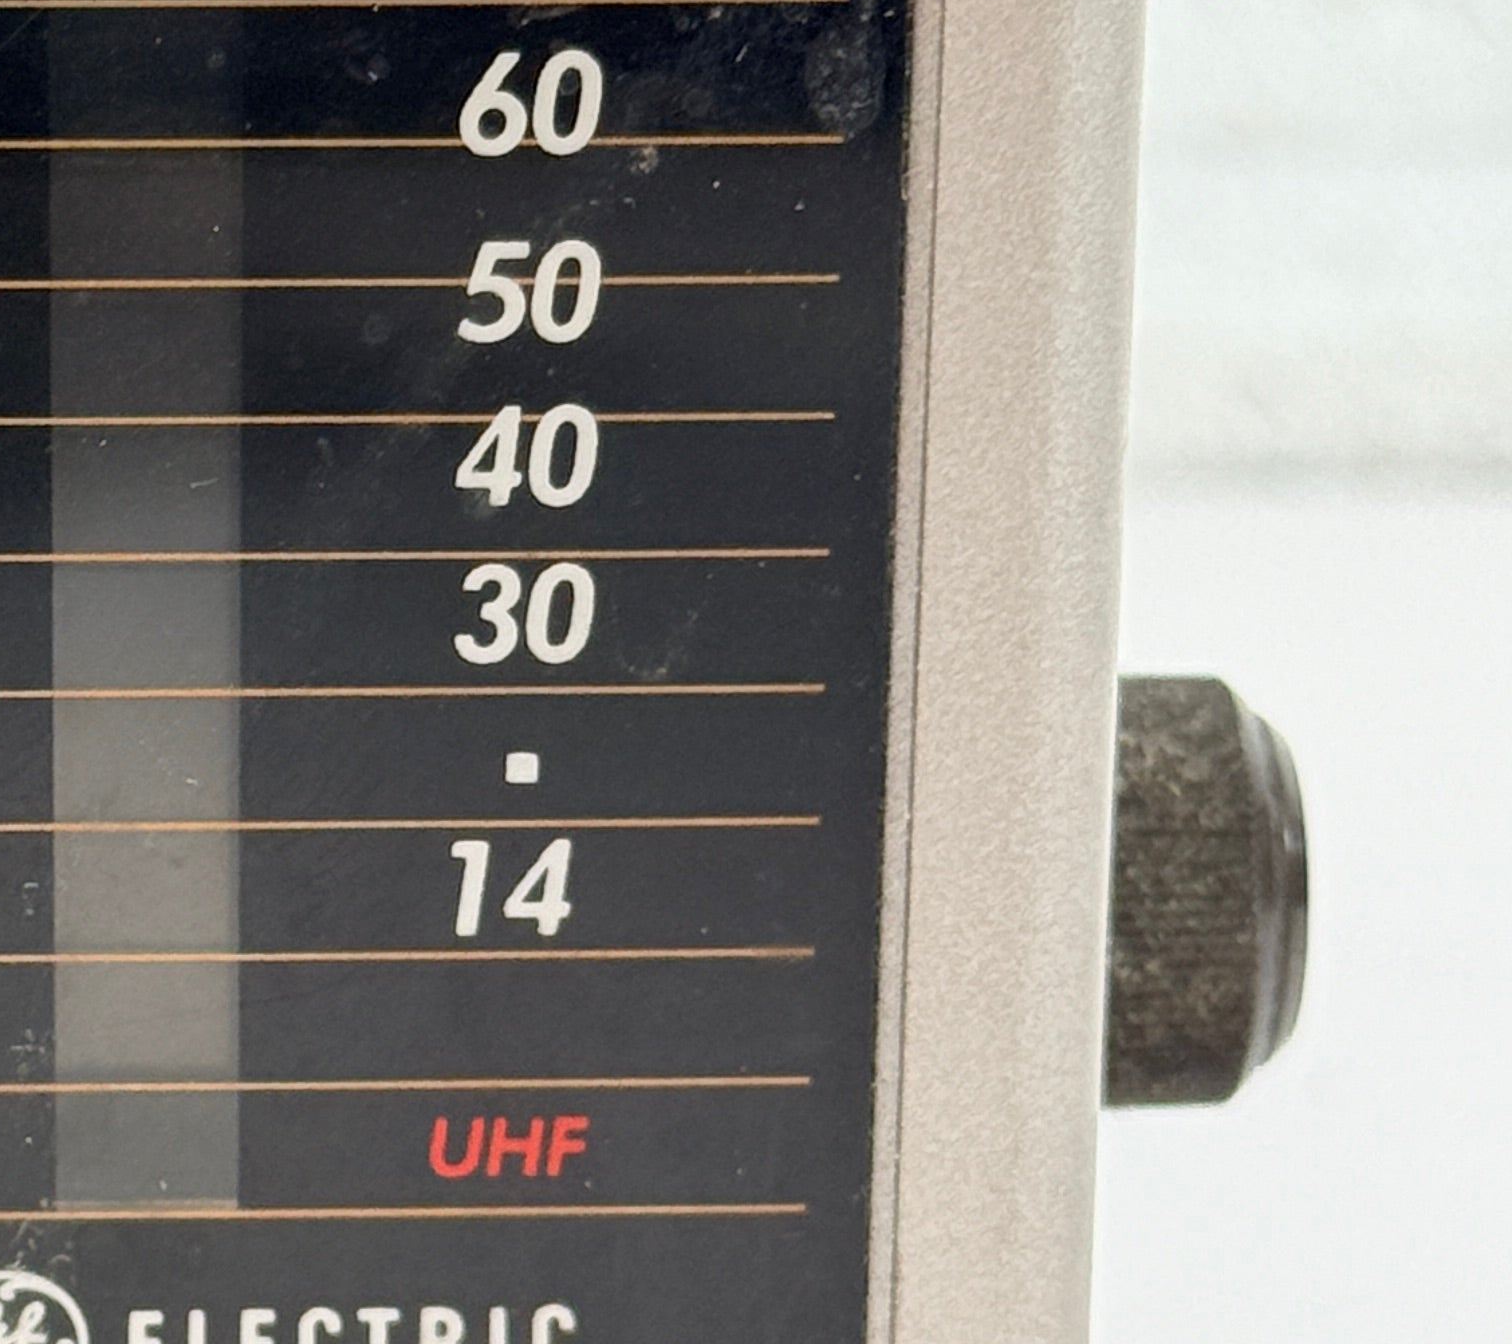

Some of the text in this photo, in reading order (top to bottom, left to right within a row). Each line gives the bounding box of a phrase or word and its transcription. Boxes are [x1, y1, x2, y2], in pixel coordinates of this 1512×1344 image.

[459, 49, 603, 156] 60
[458, 239, 602, 343] 50
[455, 403, 599, 507] 40
[454, 562, 595, 665] 30
[451, 838, 572, 937] 14
[429, 1115, 589, 1179] UHF
